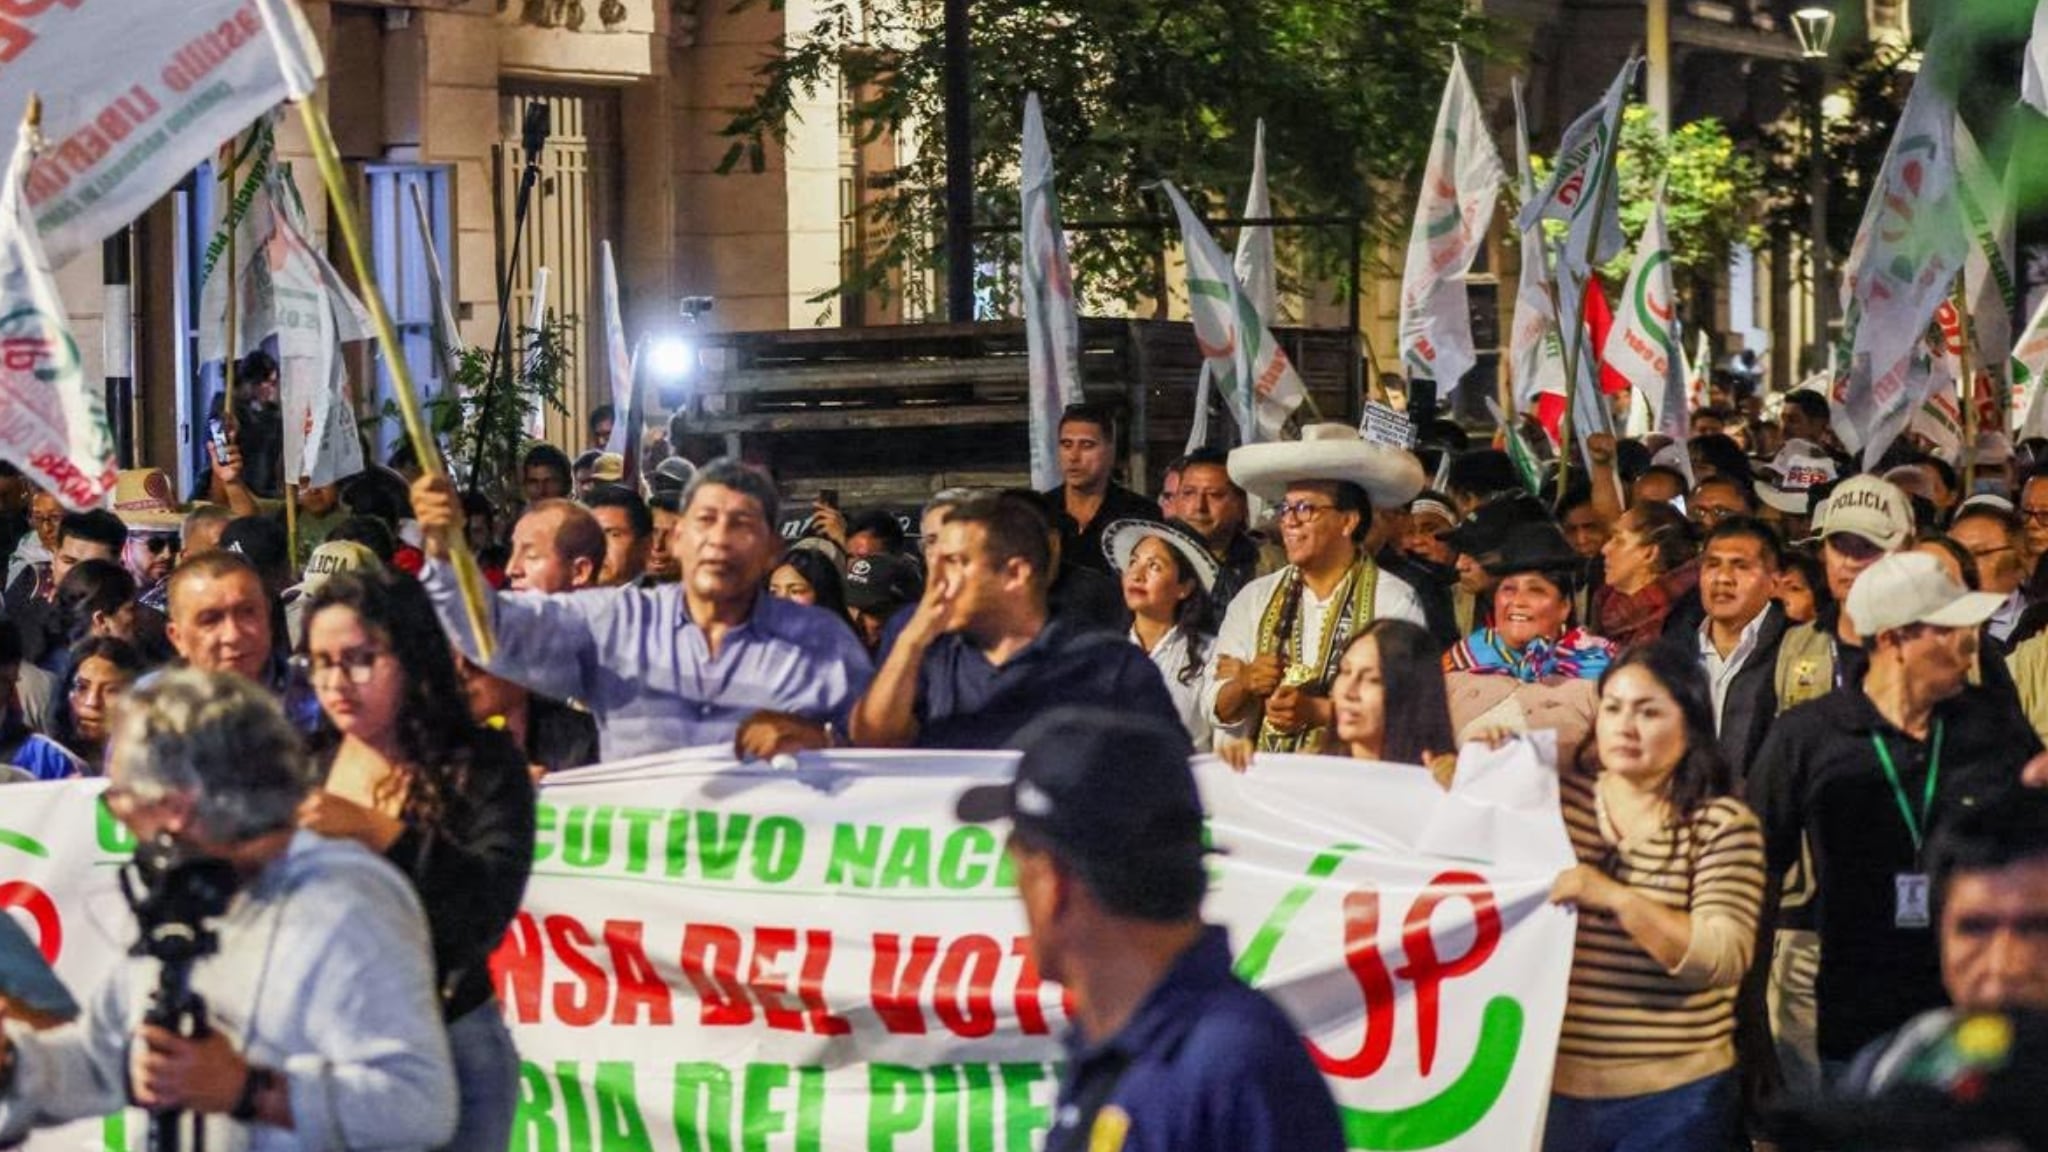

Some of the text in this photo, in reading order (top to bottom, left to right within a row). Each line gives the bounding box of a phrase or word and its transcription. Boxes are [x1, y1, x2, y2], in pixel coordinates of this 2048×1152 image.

[1830, 490, 1892, 519] POLICIA
[825, 822, 1020, 890] NACI
[681, 922, 853, 1037] DEL
[869, 931, 1080, 1039] VOT
[866, 1061, 1062, 1152] PUE
